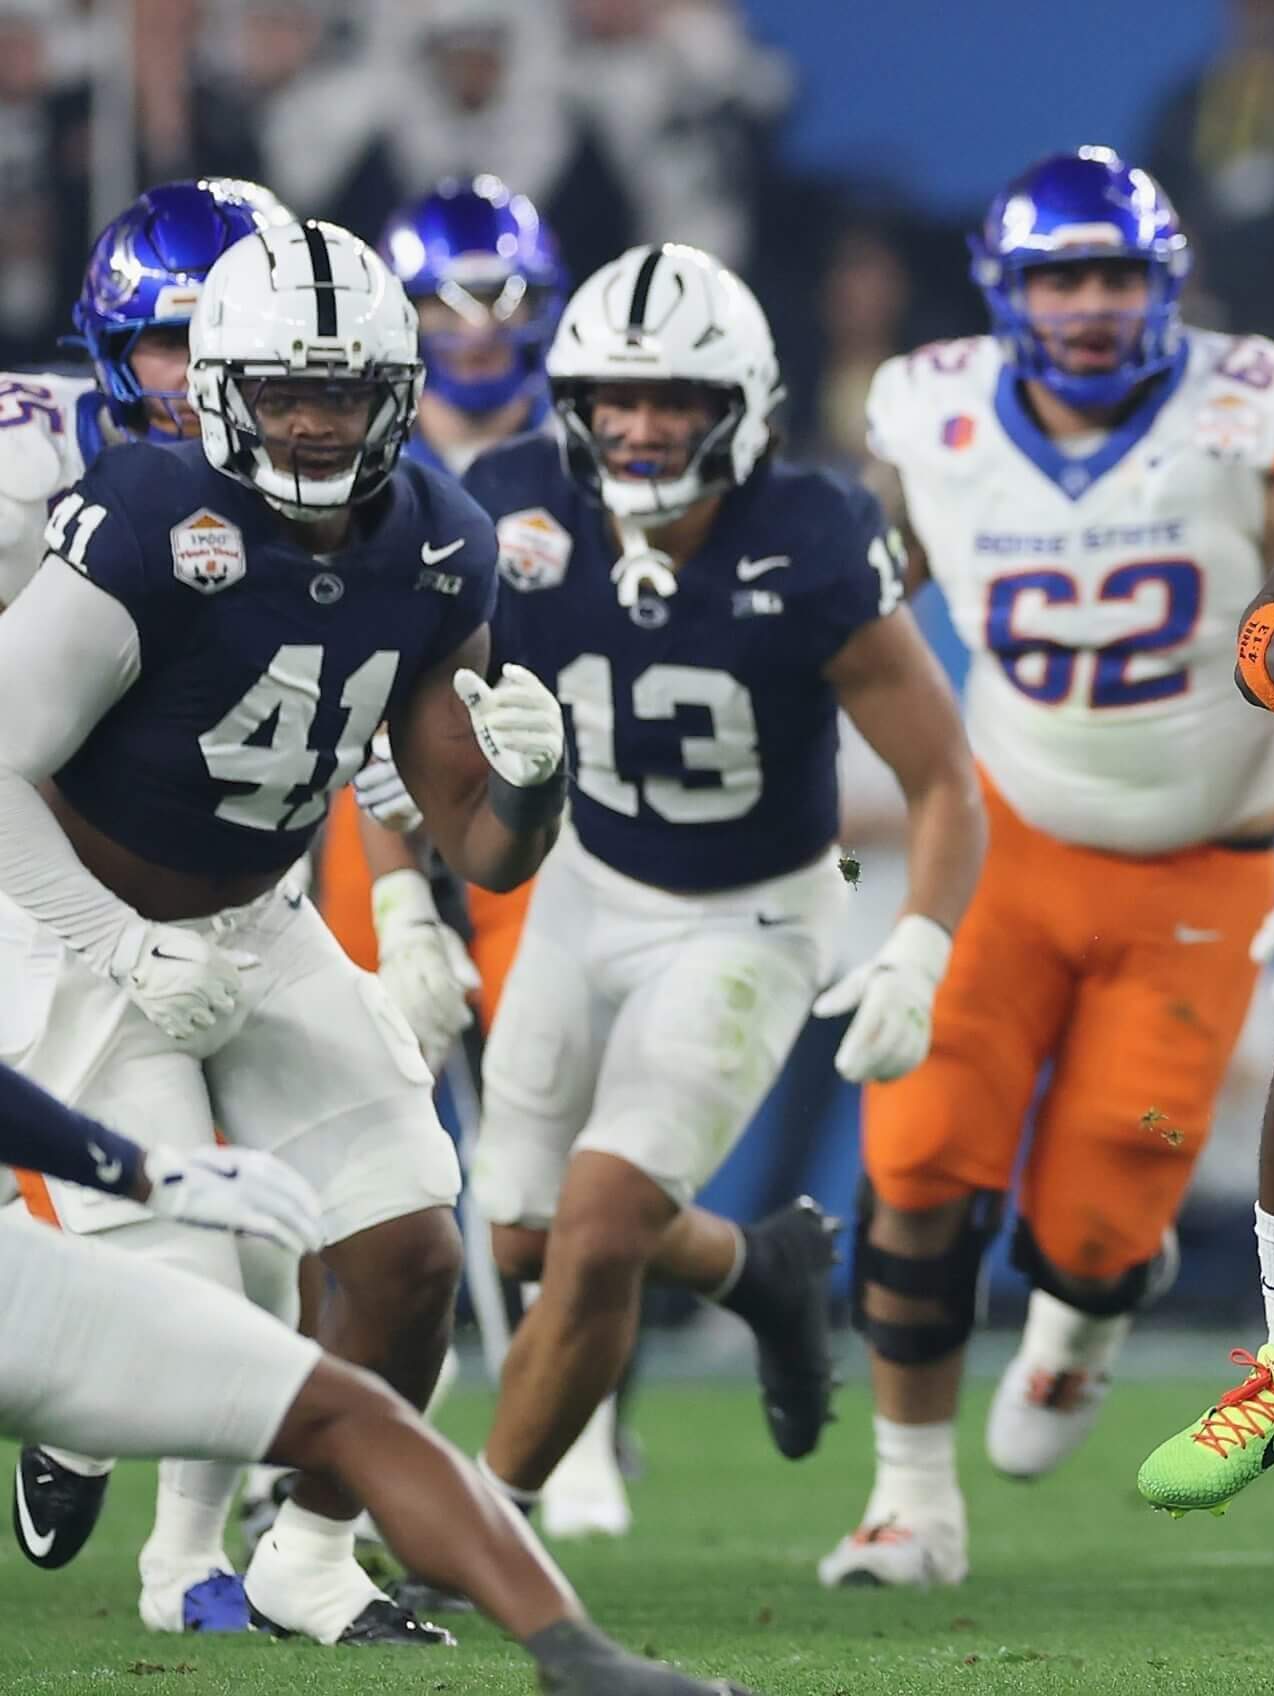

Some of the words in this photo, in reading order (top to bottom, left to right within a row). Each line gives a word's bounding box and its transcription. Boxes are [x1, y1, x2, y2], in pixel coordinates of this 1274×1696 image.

[44, 493, 107, 567] 41
[984, 555, 1206, 710] 62
[1248, 624, 1270, 664] 4:13
[198, 644, 400, 832] 41
[557, 652, 764, 824] 13
